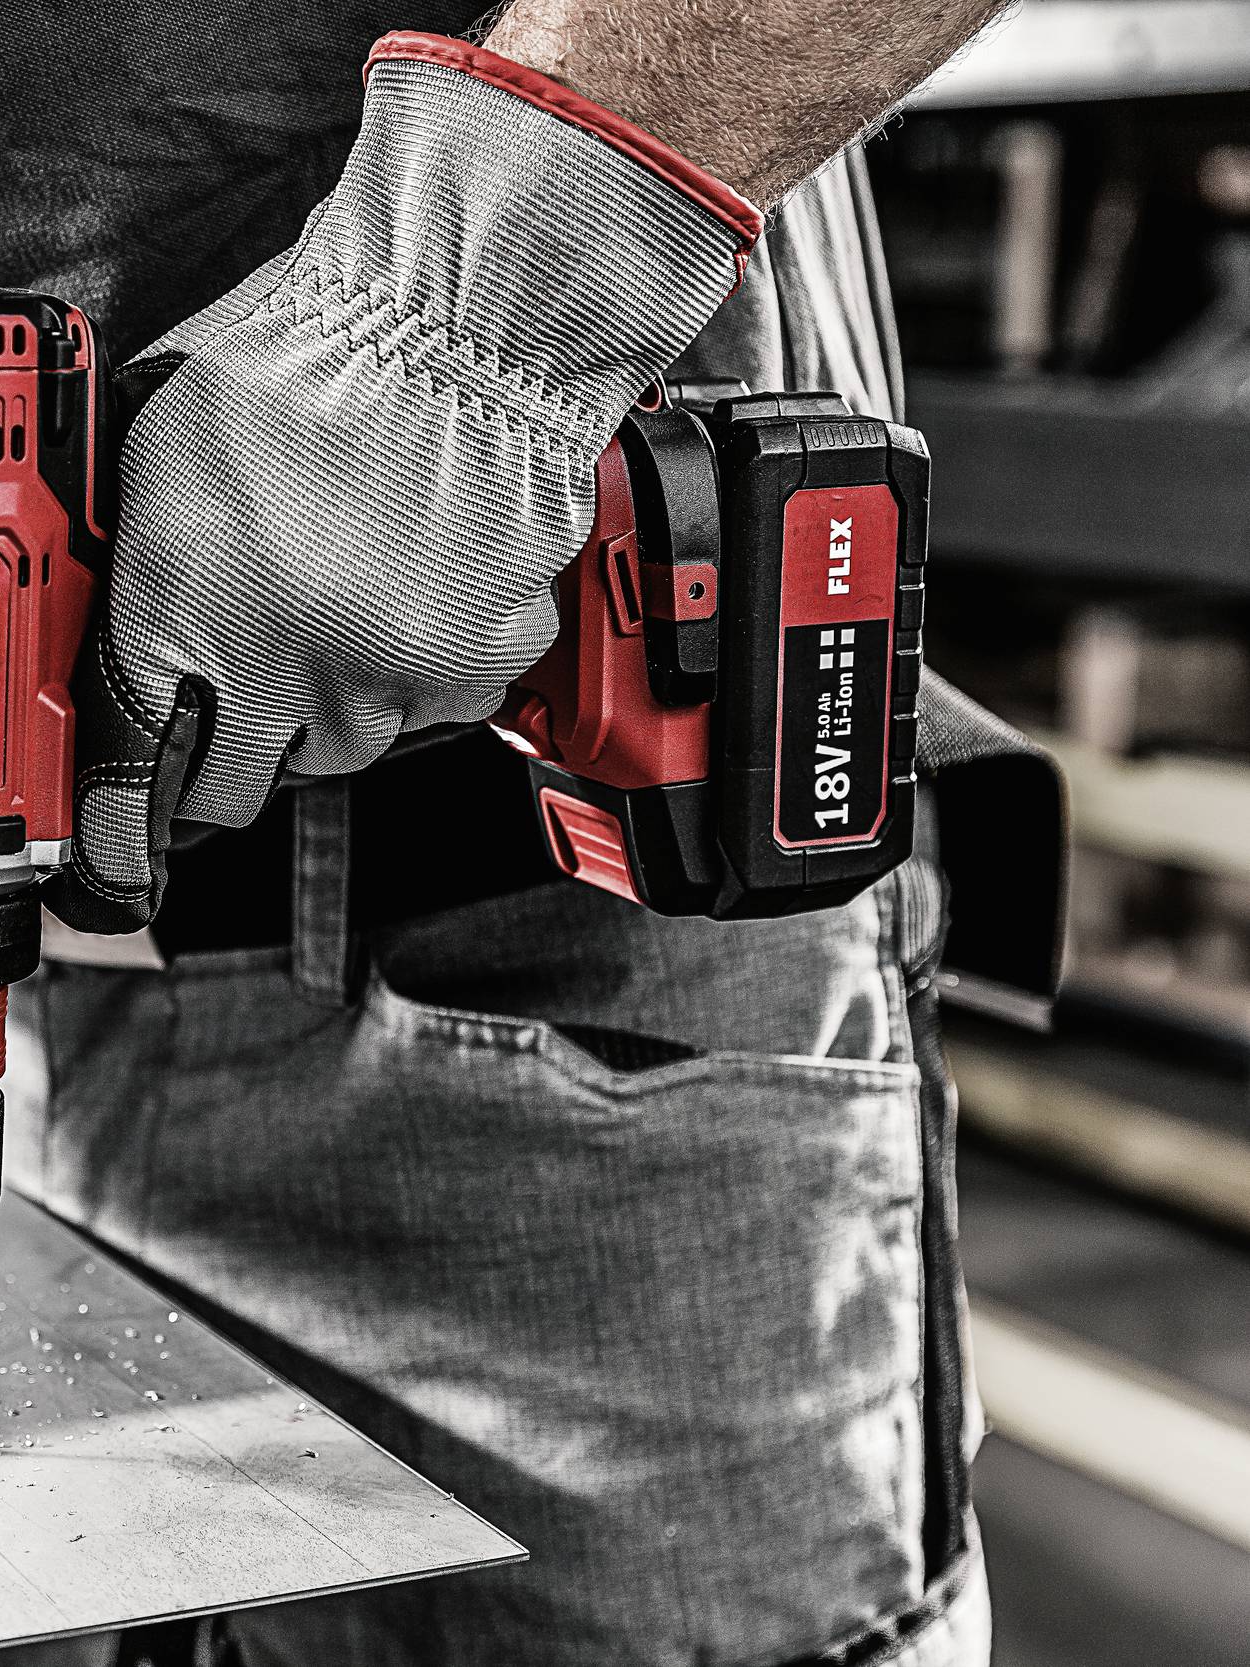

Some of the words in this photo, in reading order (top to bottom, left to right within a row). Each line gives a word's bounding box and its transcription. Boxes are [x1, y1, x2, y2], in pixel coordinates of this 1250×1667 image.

[827, 516, 853, 595] FLEX
[817, 714, 831, 739] 5.0
[818, 692, 831, 712] Ah
[834, 672, 853, 736] Li-Ion
[814, 743, 851, 829] 18V
